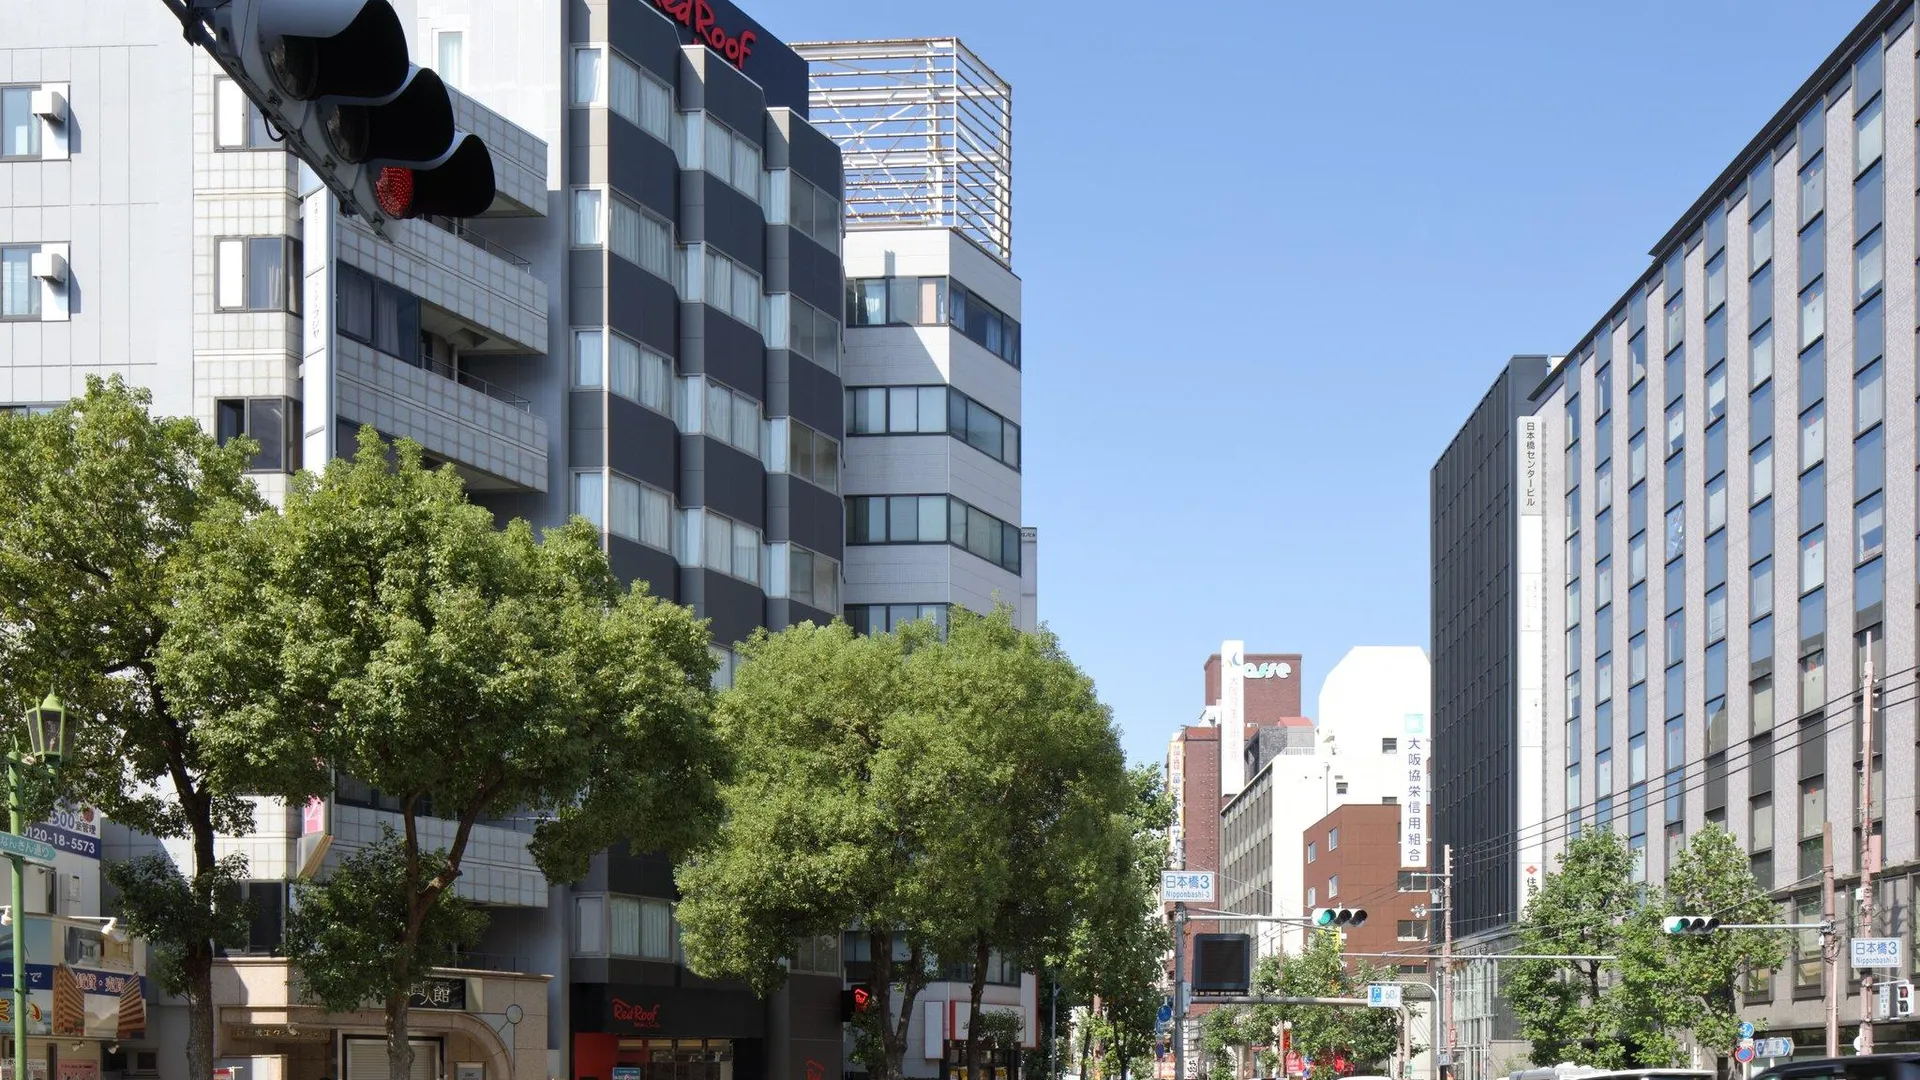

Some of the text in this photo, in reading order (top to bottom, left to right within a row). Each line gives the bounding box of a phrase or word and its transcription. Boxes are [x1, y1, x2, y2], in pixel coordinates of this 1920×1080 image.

[1526, 421, 1536, 507] 日本橋センタービル
[1407, 736, 1421, 863] 大阪協栄信用組合
[1165, 874, 1210, 890] 日本橋3
[1165, 890, 1211, 900] Nipponbashi-3
[1855, 941, 1898, 955] 日本橋3
[1855, 956, 1898, 966] Nipponbashi-3
